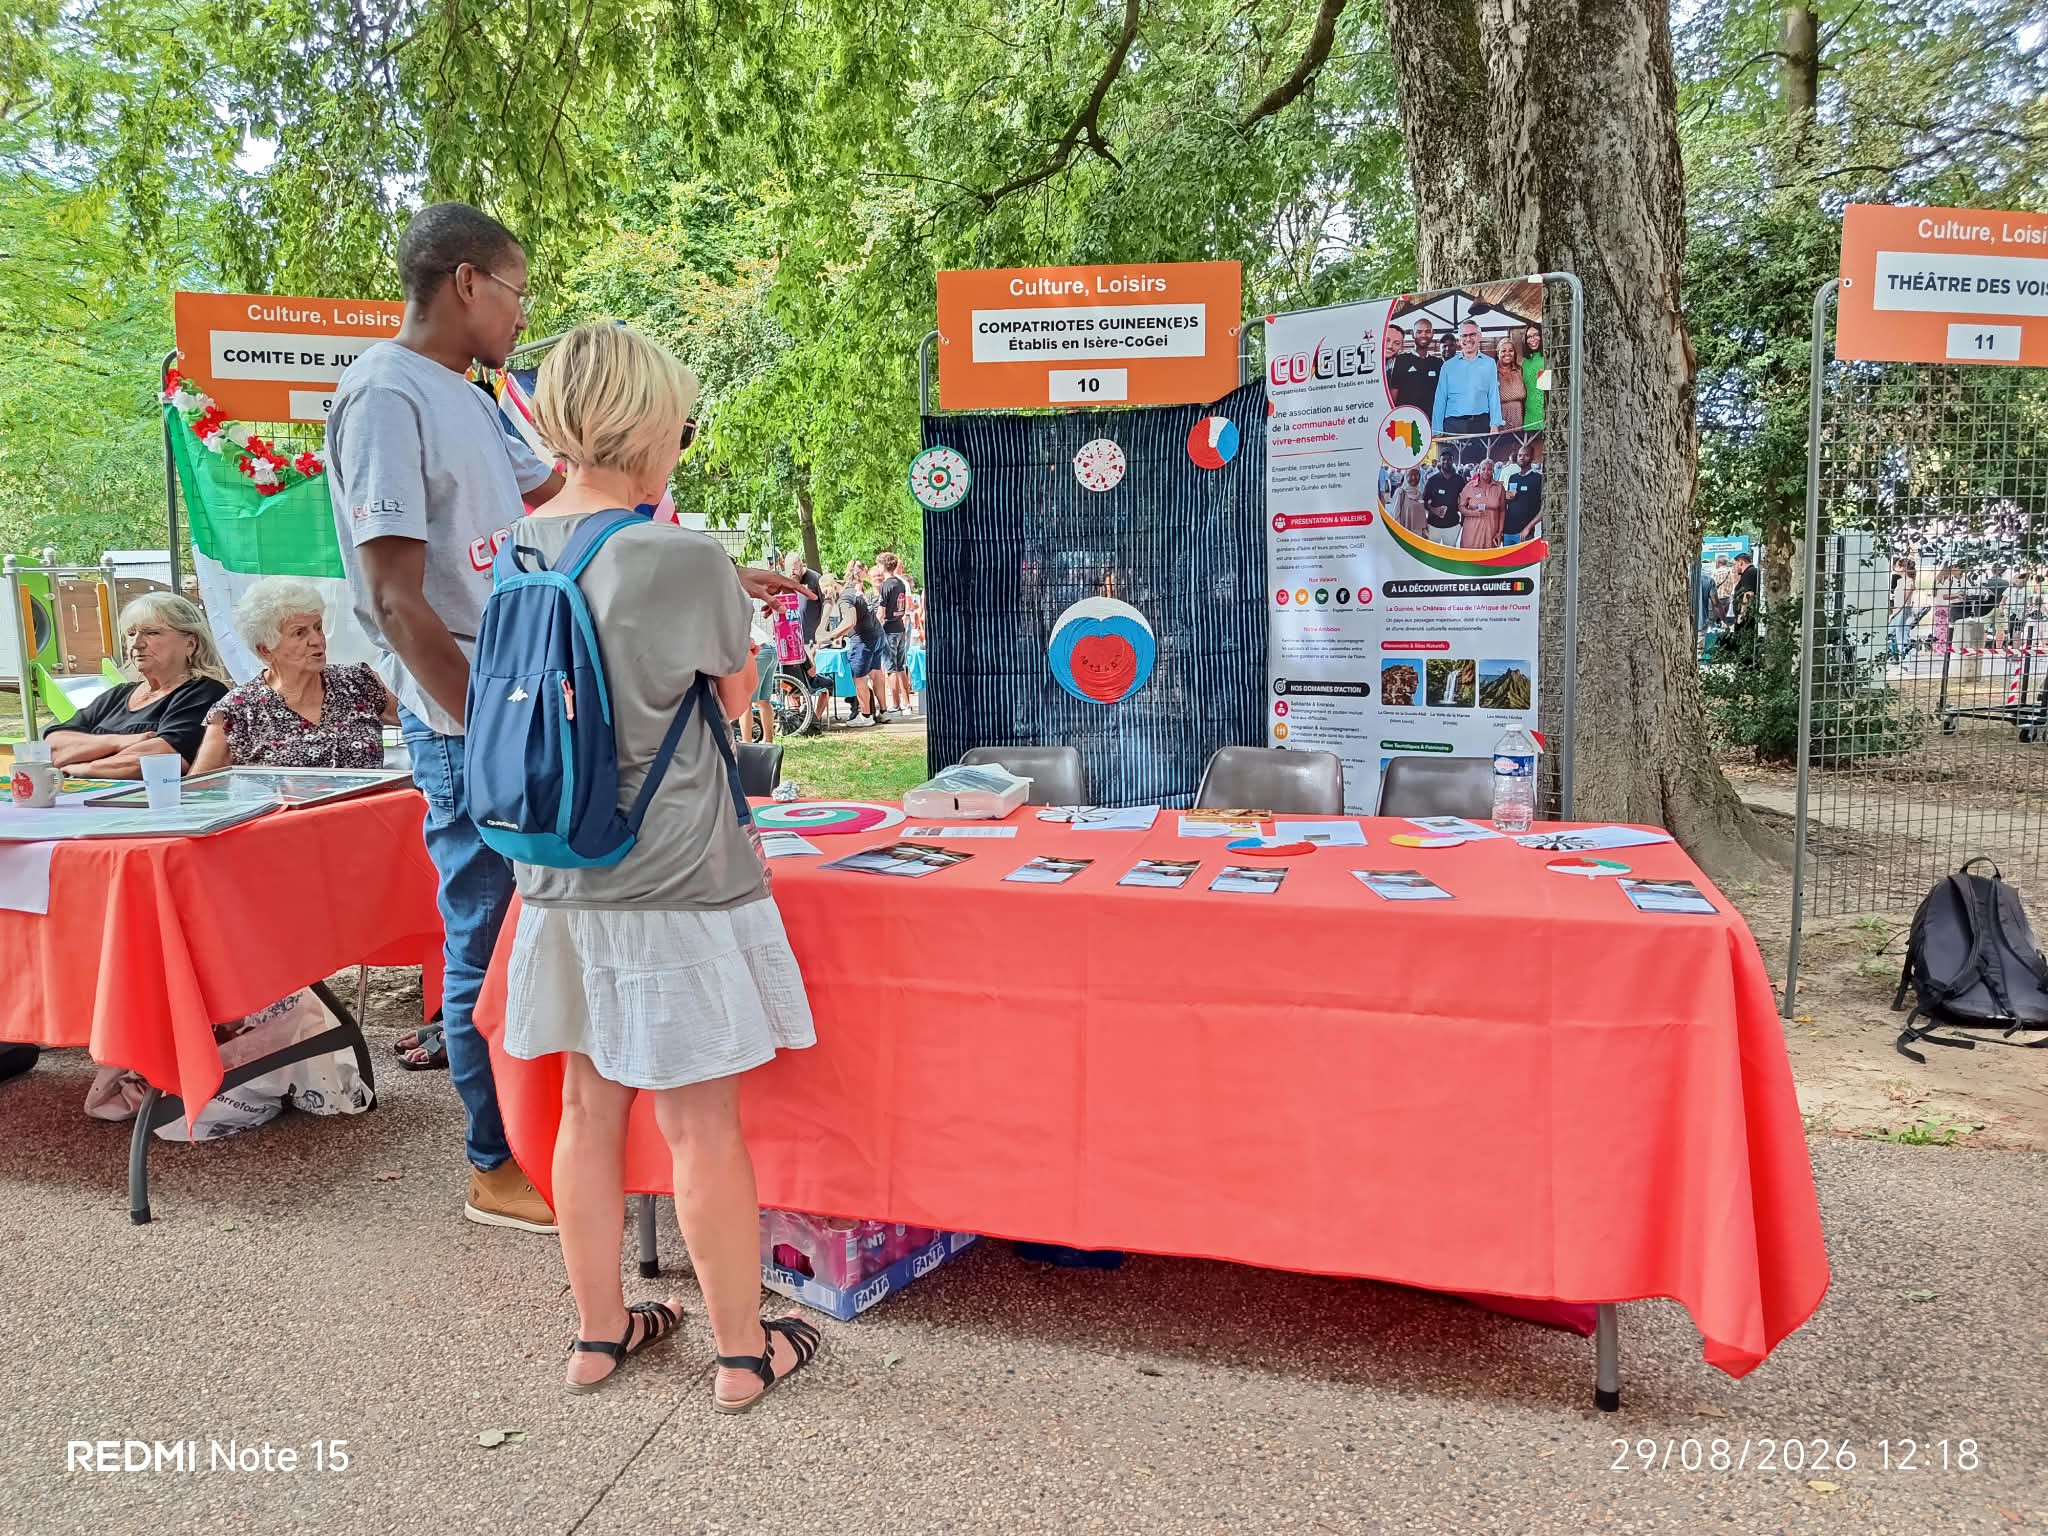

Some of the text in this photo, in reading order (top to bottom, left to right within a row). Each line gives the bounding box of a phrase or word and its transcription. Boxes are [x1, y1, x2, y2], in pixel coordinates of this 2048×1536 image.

[1918, 219, 1995, 244] Culture,
[1009, 275, 1168, 297] Culture, Loisirs
[1887, 272, 1971, 293] THÉÂTRE
[1976, 278, 2011, 294] DES
[247, 304, 401, 327] Culture, Loisirs
[979, 316, 1199, 334] COMPATRIOTES GUINEEN(E)S
[1009, 334, 1168, 351] Établis en Isère-CoGei
[1974, 334, 1994, 350] 11
[223, 349, 358, 367] COMITE DE JU
[1077, 377, 1100, 393] 10
[1289, 405, 1332, 417] association
[1333, 404, 1343, 412] au
[1345, 400, 1374, 411] service
[1272, 414, 1369, 433] de la communauté et du
[1272, 433, 1338, 446] vivre-ensemble.
[1291, 516, 1333, 526] PRÉSENTATION
[1340, 514, 1367, 522] VALEURS
[1391, 581, 1511, 593] À LA DÉCOUVERTE DE LA GUINÉE
[1509, 603, 1531, 611] l'Ouest
[1303, 685, 1333, 693] DOMAINES
